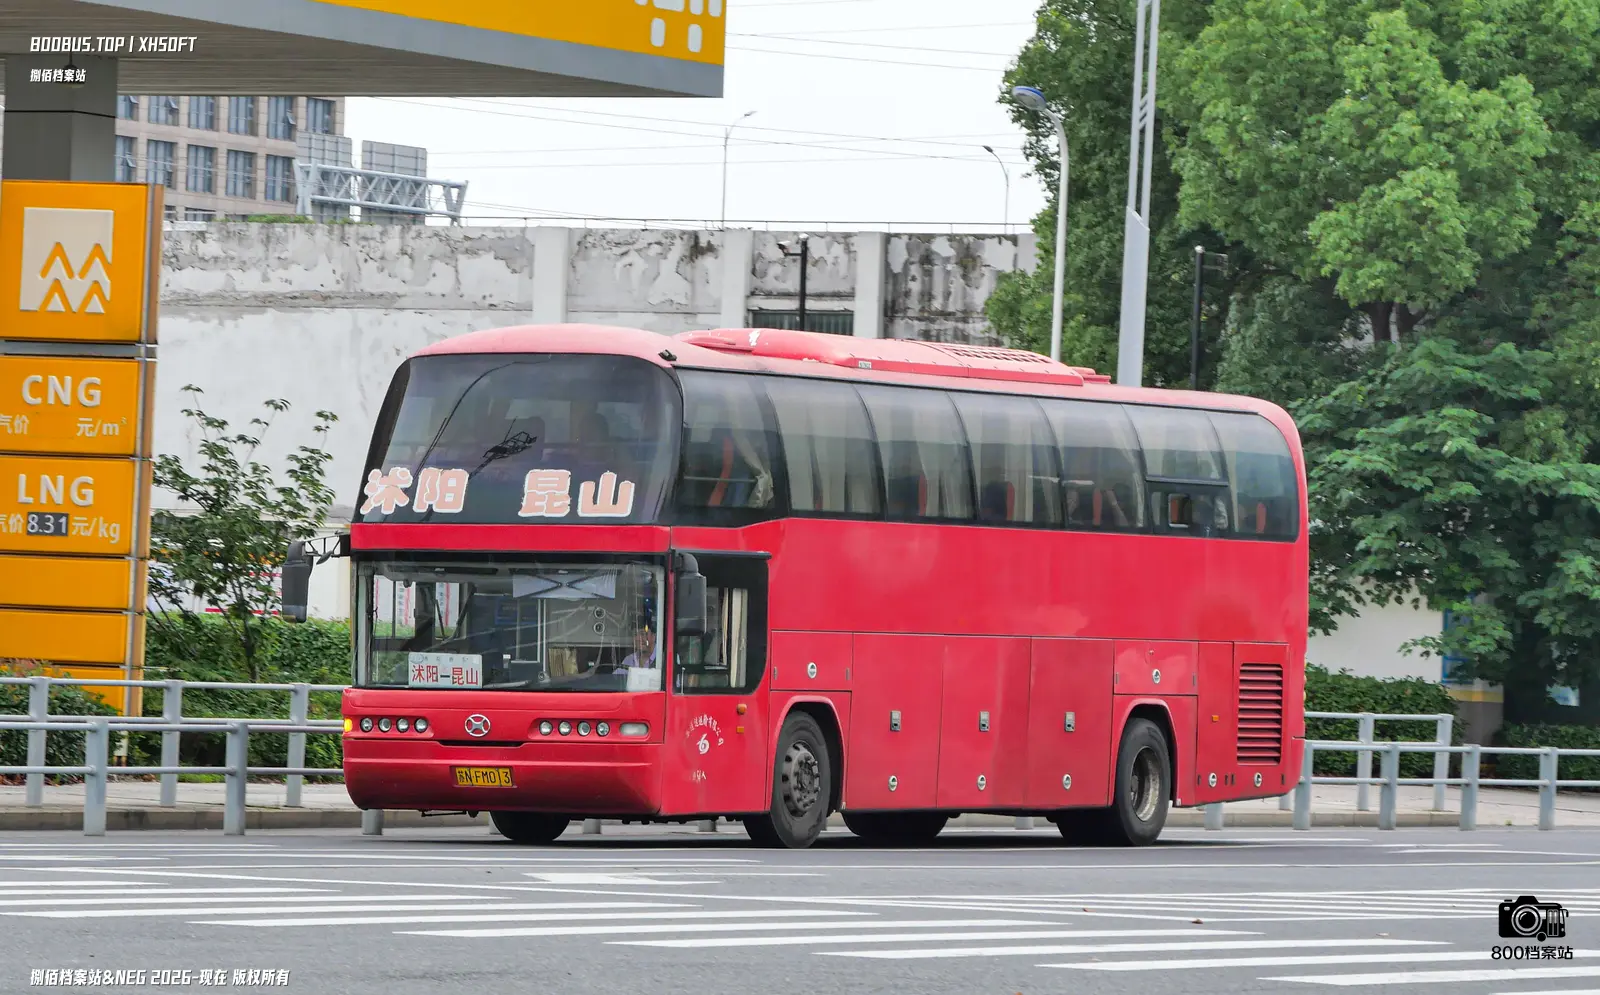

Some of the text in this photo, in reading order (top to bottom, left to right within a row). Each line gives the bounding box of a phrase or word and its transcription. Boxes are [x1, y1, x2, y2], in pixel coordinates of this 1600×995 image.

[21, 374, 102, 408] CNG
[17, 473, 95, 507] LNG
[360, 467, 636, 518] 沭阳 昆山
[27, 514, 67, 534] 8.31
[72, 516, 121, 544] 元/kg
